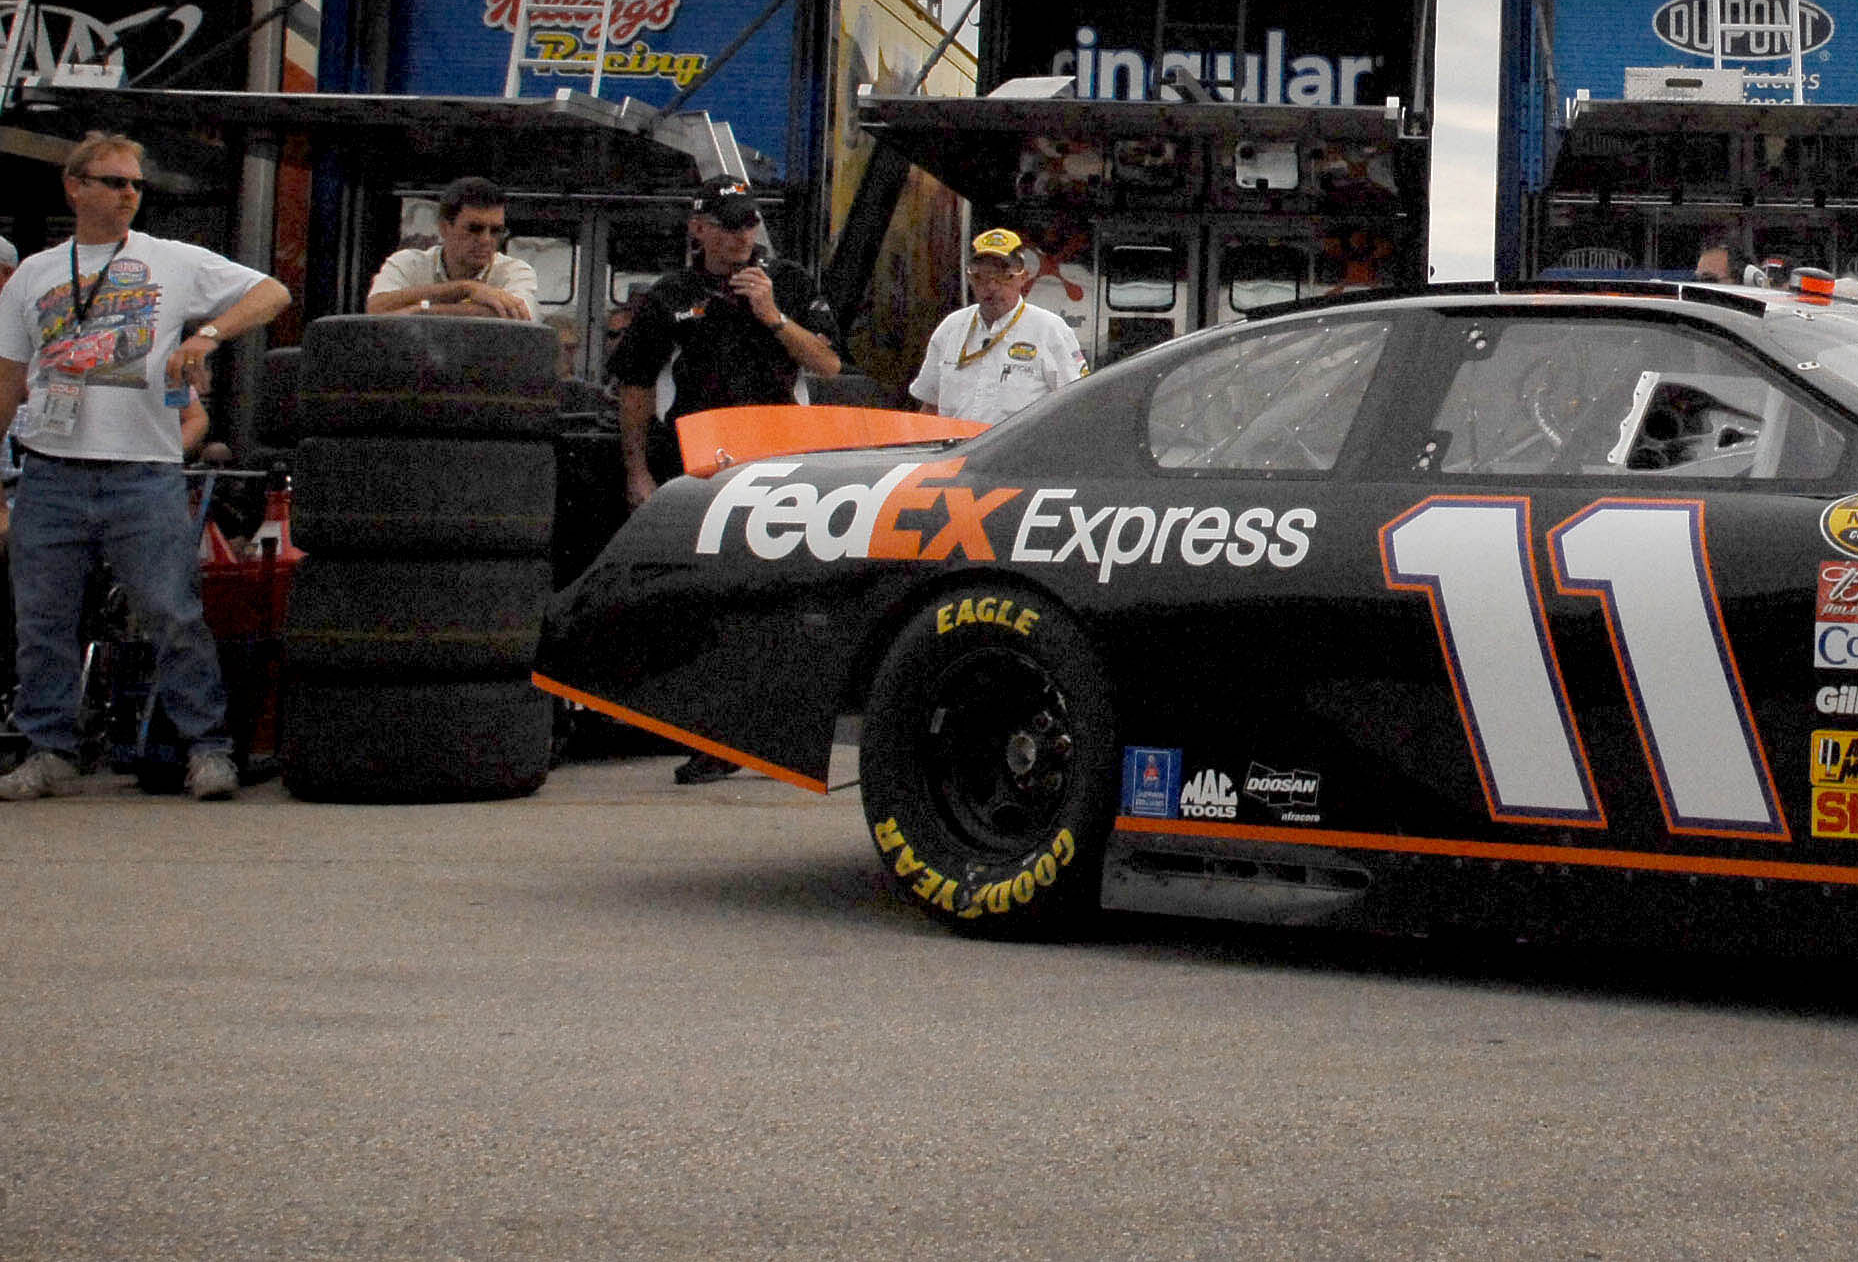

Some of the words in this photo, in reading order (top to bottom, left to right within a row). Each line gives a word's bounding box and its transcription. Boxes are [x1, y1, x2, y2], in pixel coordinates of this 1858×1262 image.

[695, 456, 1022, 562] FedEx
[1010, 488, 1317, 583] Express
[937, 596, 1040, 637] EAGLE
[1379, 495, 1793, 842] 11
[1180, 768, 1238, 805] MAC
[1246, 777, 1317, 793] DOOSAN
[1181, 805, 1237, 819] TOOLS
